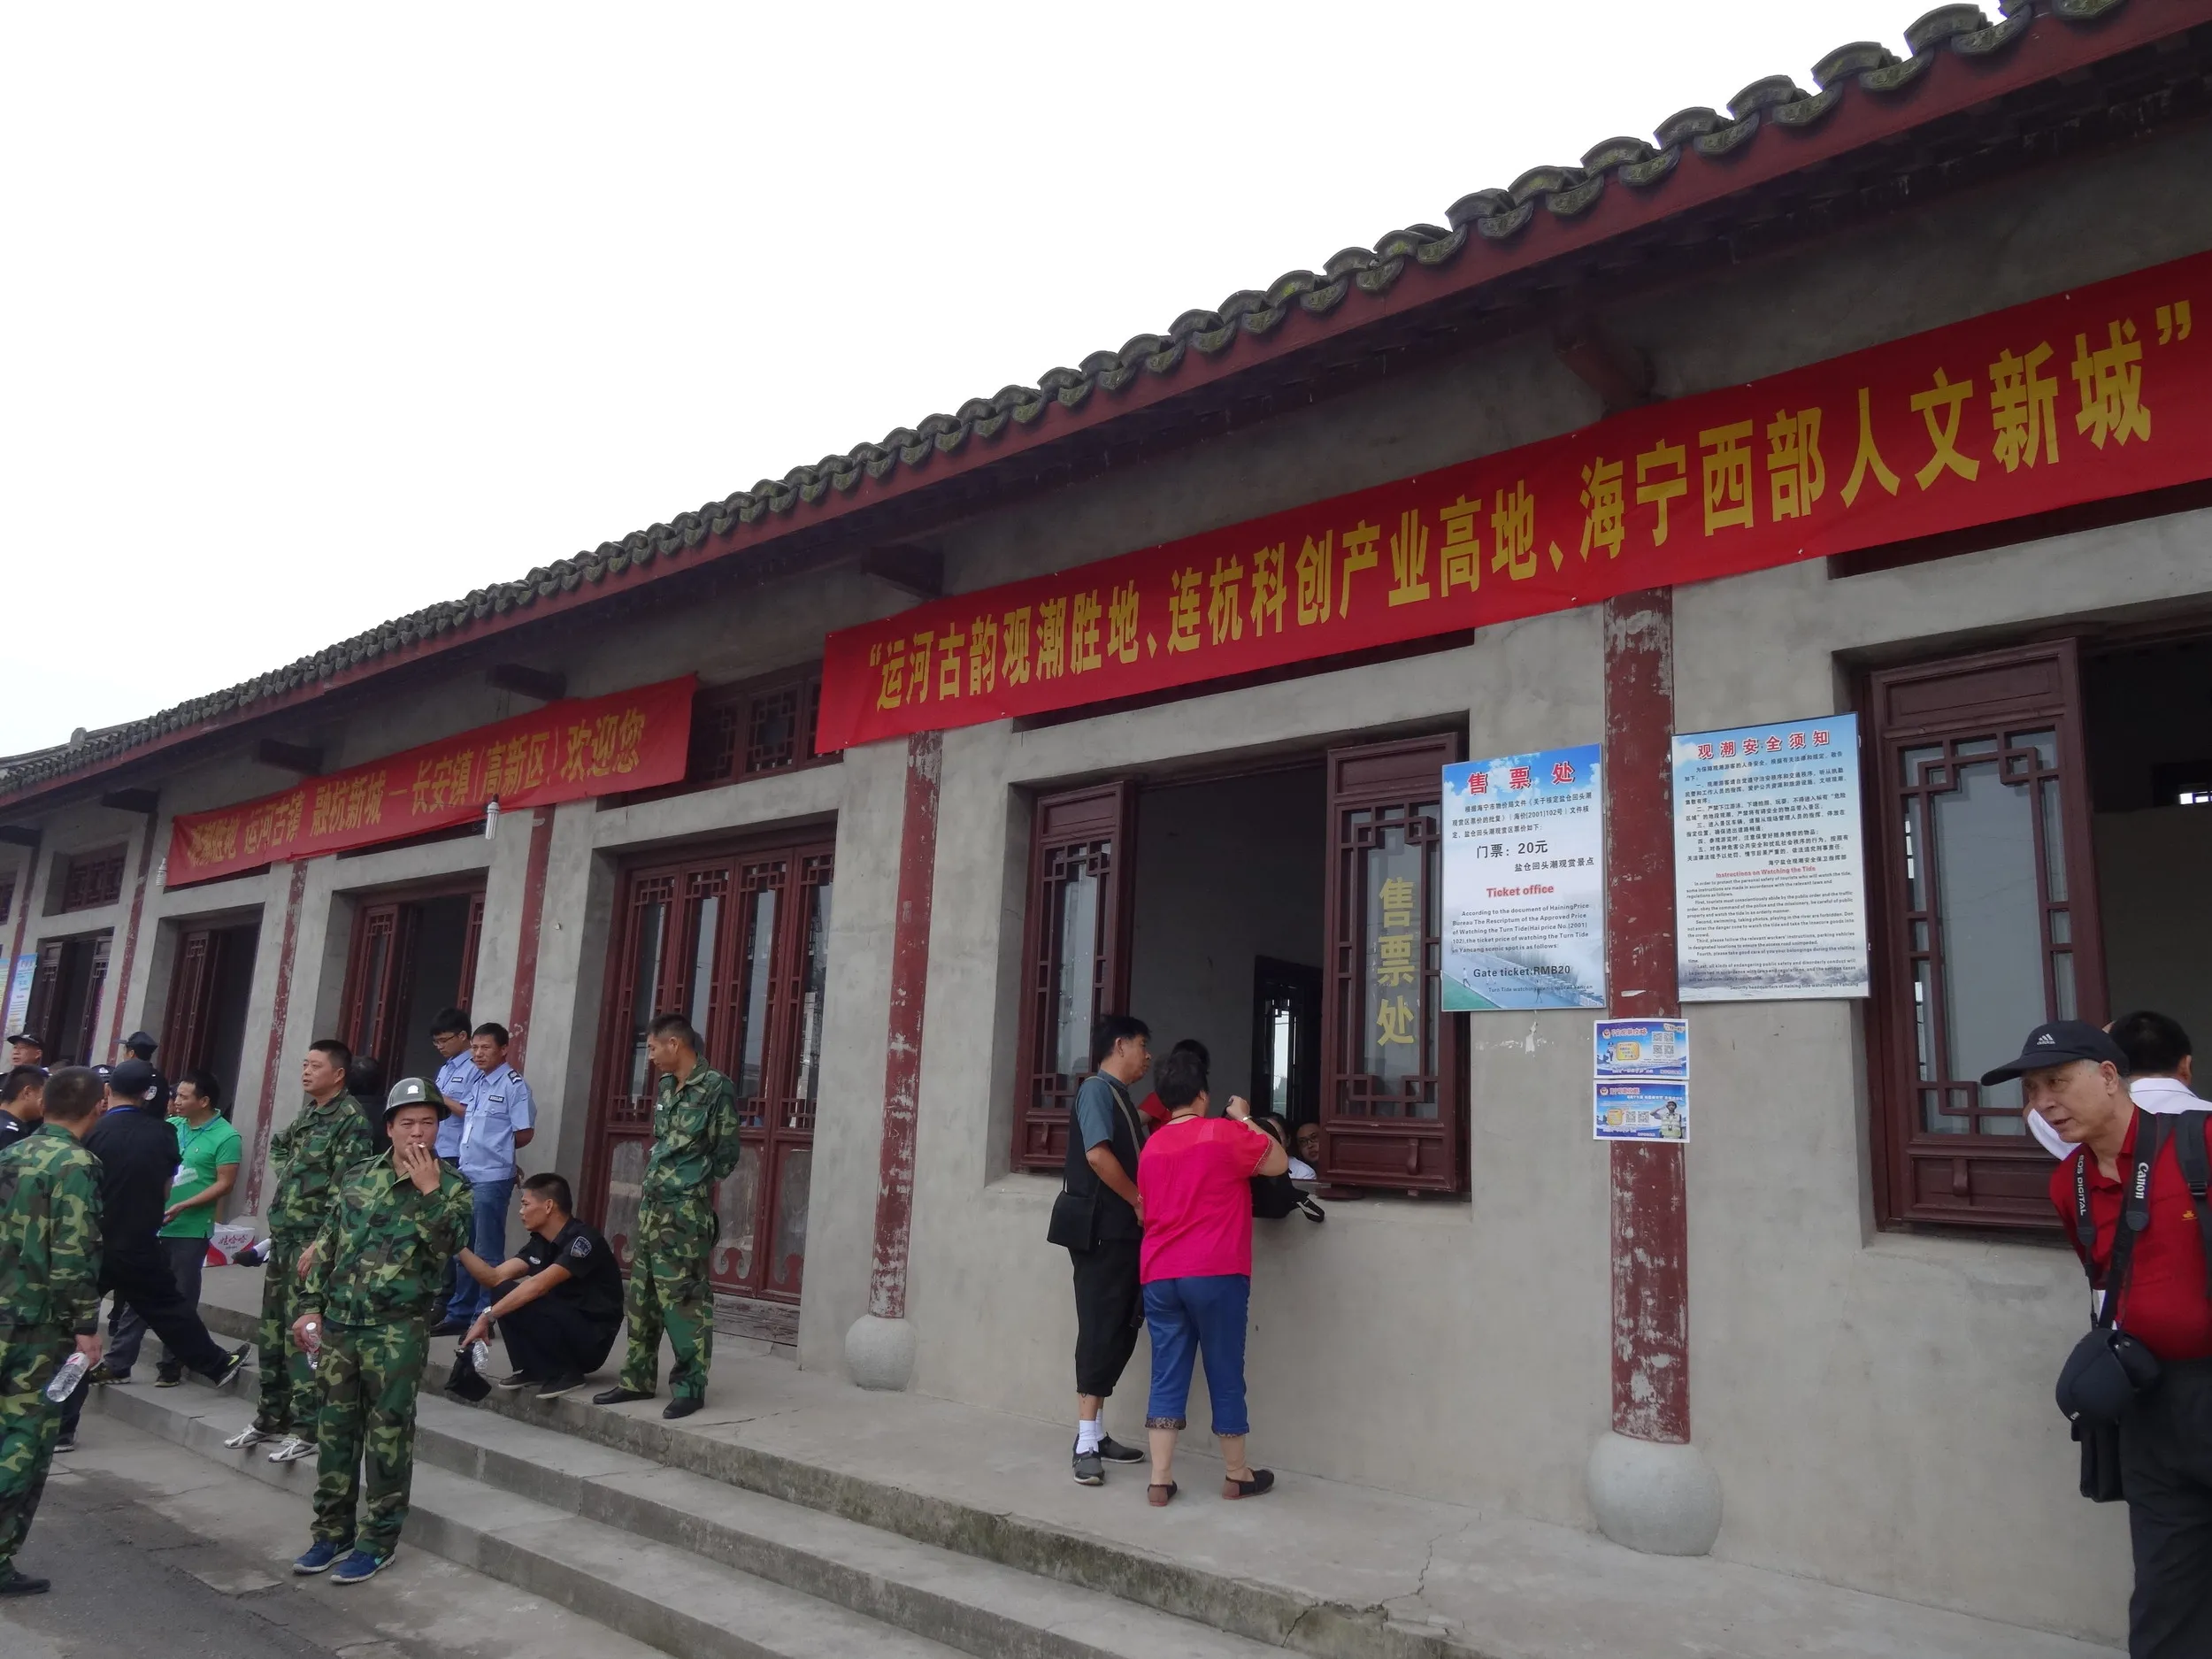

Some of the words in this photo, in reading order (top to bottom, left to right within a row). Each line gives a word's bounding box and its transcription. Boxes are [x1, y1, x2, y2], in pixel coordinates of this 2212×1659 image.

[560, 706, 646, 782] 欢迎您
[1697, 728, 1831, 760] 观潮安全须知
[1467, 758, 1575, 795] 售票处
[1514, 856, 1594, 872] 盐仓回头潮观赏景点
[1486, 886, 1519, 898] Ticket
[1523, 883, 1554, 895] office
[1376, 876, 1416, 1046] 售票处
[1473, 968, 1497, 977] Gate
[2077, 1177, 2087, 1216] DIGITAL
[2134, 1162, 2149, 1199] Canon
